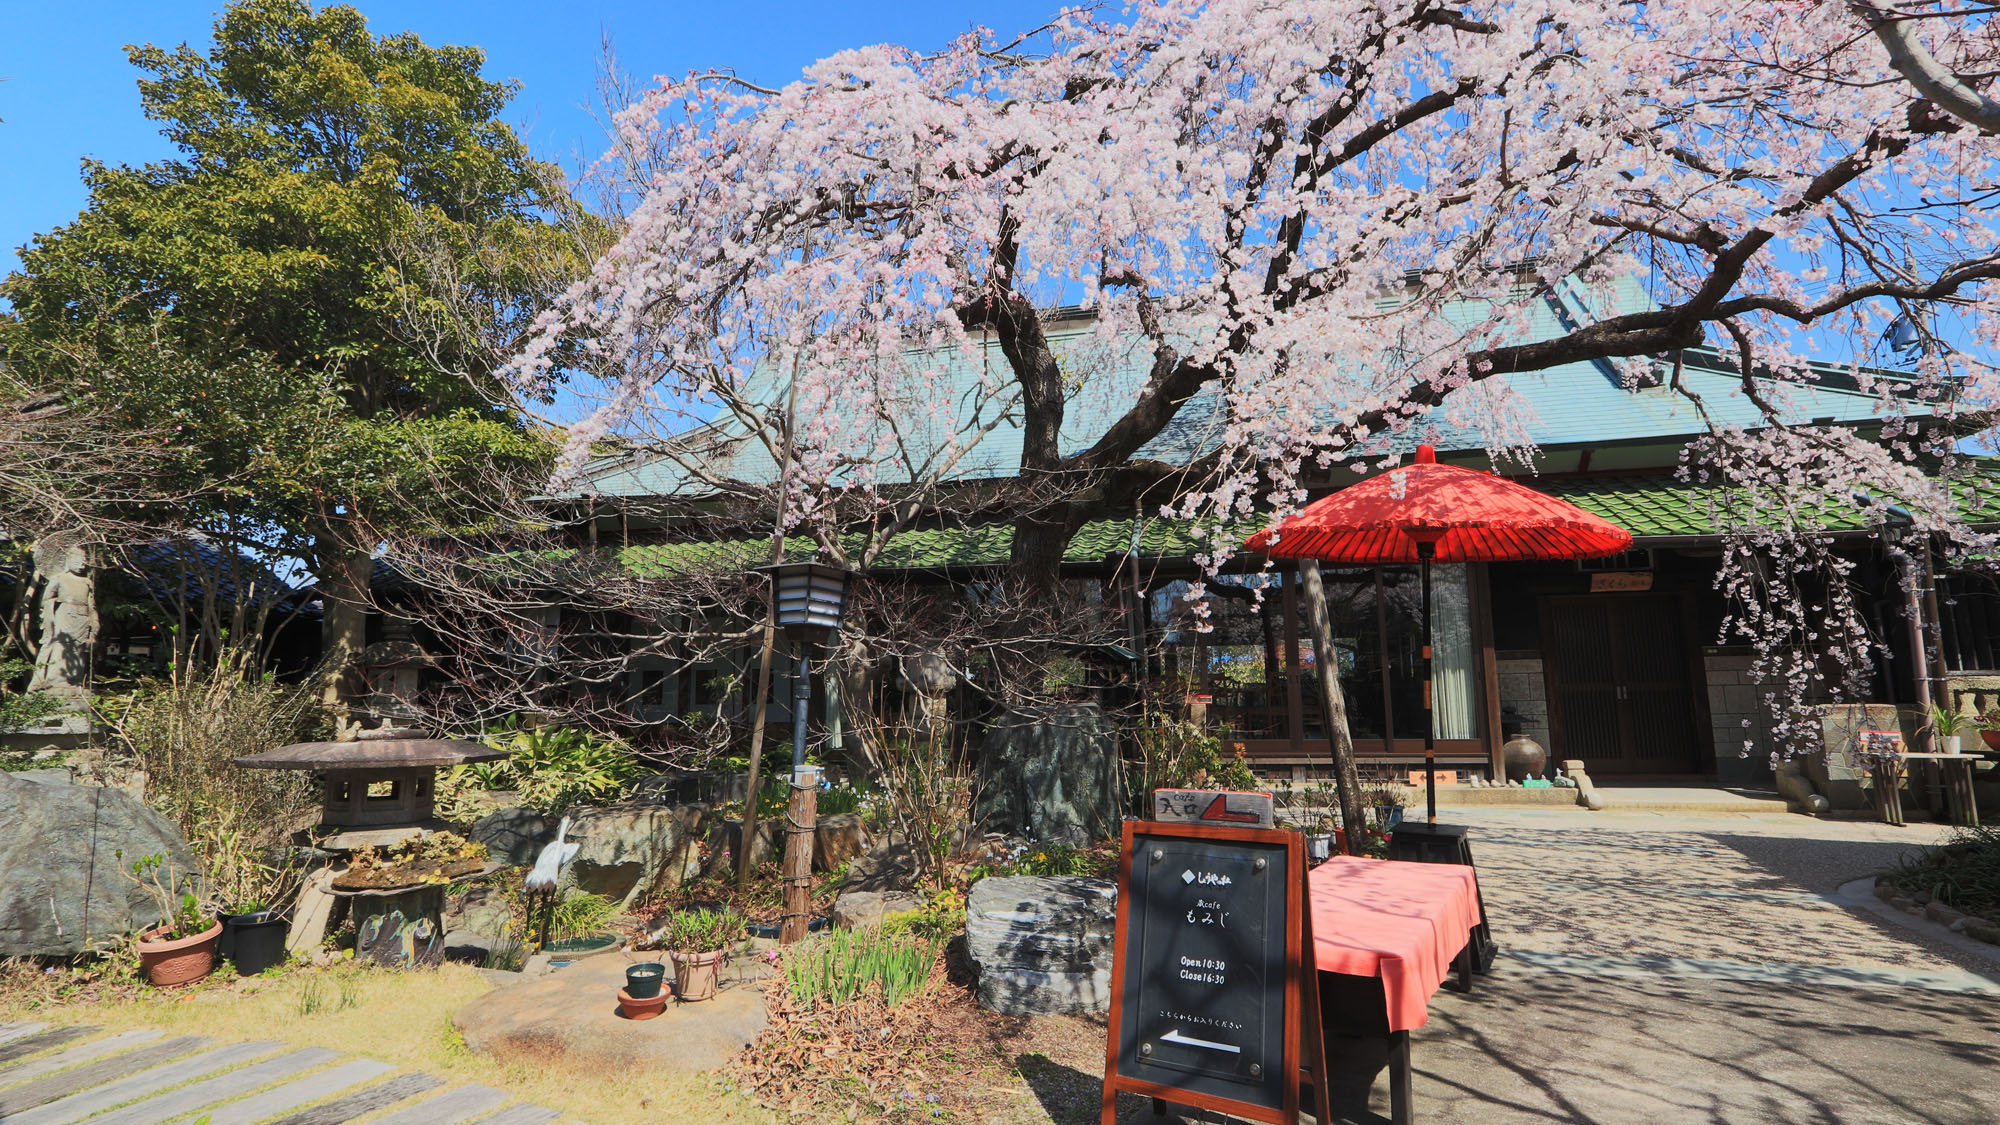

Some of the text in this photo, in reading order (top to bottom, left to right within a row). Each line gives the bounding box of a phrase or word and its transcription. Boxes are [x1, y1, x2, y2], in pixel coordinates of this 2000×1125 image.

[1159, 797, 1197, 816] 入口
[1186, 909, 1230, 928] もみじ
[1180, 955, 1225, 971] Open 10:30
[1180, 969, 1225, 985] Close 16:30
[1159, 1010, 1242, 1029] こちらからお入りください
